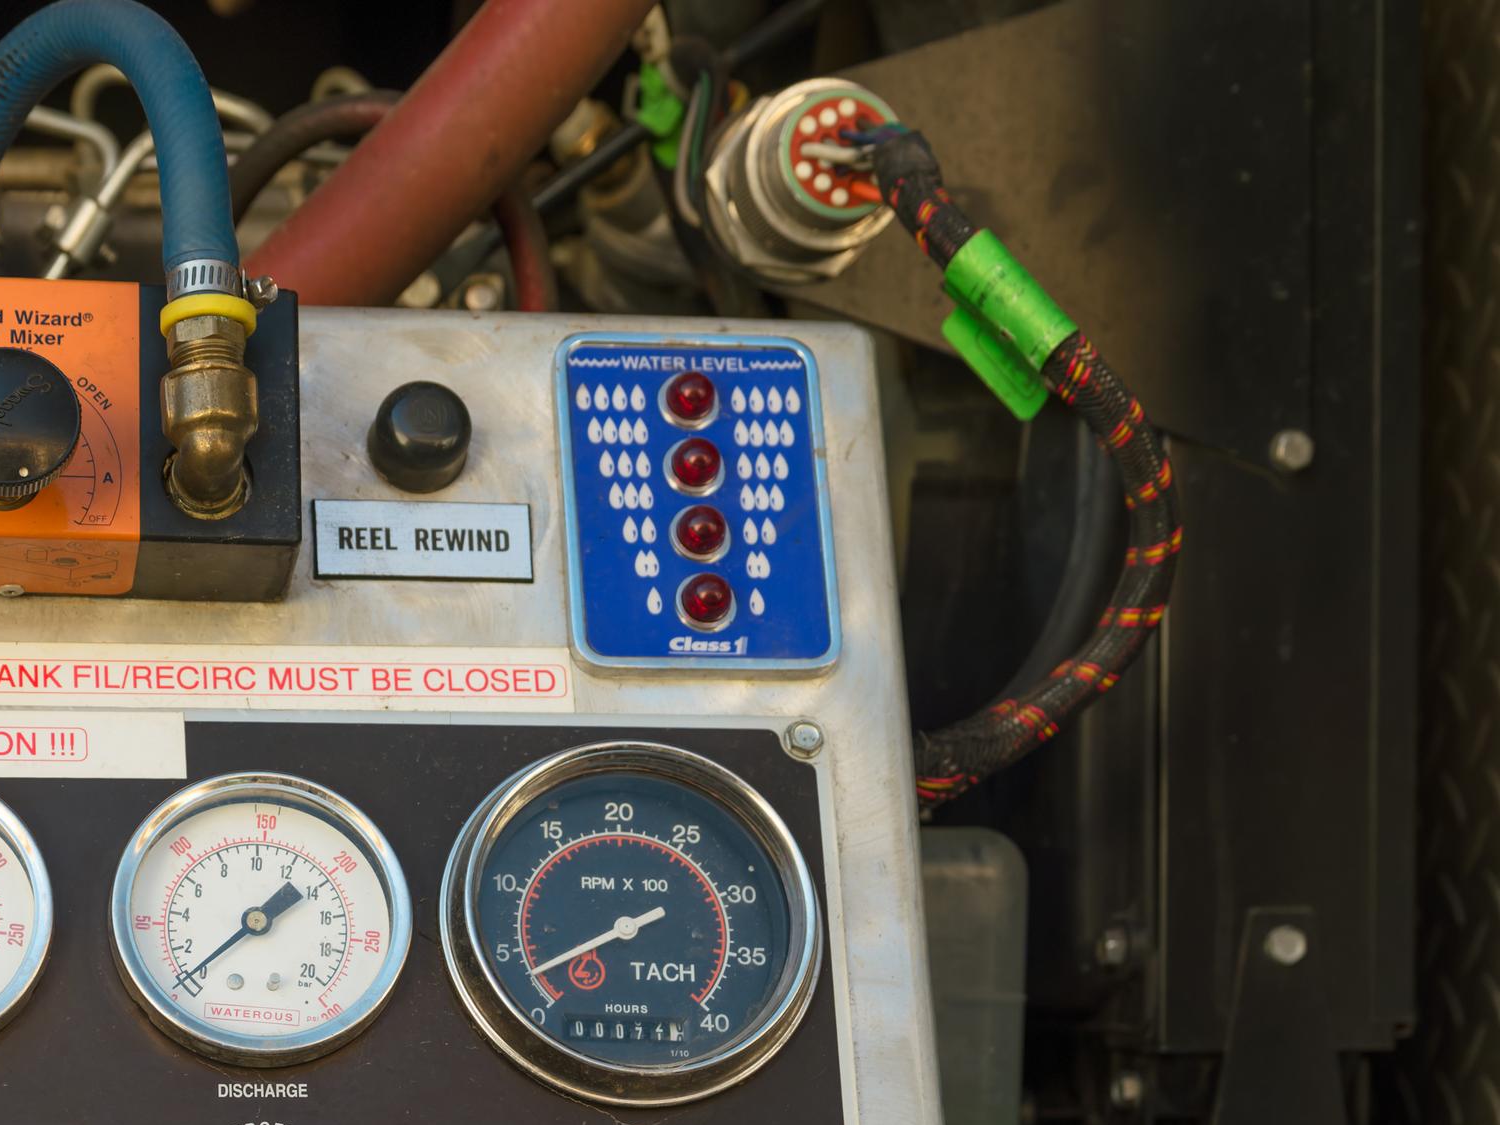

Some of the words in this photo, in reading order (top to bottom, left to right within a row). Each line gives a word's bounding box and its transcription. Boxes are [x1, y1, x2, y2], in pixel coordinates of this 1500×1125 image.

[10, 329, 64, 346] Mixer
[621, 355, 686, 371] WATER
[691, 356, 749, 372] LEVEL
[77, 376, 112, 411] OPEN
[103, 472, 113, 484] A
[338, 528, 397, 550] REEL
[415, 529, 510, 552] REWIND
[74, 664, 256, 690] FIL/RECIRC
[268, 667, 359, 691] MUST
[372, 668, 412, 692] BE
[423, 668, 556, 692] CLOSED
[50, 732, 75, 756] !!!
[604, 802, 634, 822] 20
[256, 814, 276, 829] 150
[540, 821, 563, 839] 15
[672, 824, 700, 843] 25
[169, 836, 192, 857] 100
[251, 858, 262, 871] 10
[333, 851, 357, 874] 200
[220, 864, 228, 878] 8
[280, 866, 292, 879] 12
[493, 874, 516, 891] 10
[581, 876, 615, 891] RPM
[623, 878, 634, 891] X
[642, 879, 668, 892] 100
[194, 884, 202, 898] 6
[306, 886, 318, 900] 14
[727, 885, 756, 904] 30
[136, 915, 151, 930] 50
[182, 908, 190, 922] 4
[319, 911, 332, 925] 16
[7, 923, 25, 947] 250
[364, 931, 381, 953] 250
[184, 939, 192, 954] 2
[320, 942, 332, 957] 18
[496, 944, 510, 961] 5
[737, 947, 766, 965] 35
[200, 965, 207, 979] 0
[300, 963, 315, 978] 20
[630, 962, 695, 982] TACH
[298, 980, 312, 988] bar
[210, 1006, 293, 1022] WATEROUS
[605, 1003, 649, 1014] HOURS
[701, 1014, 730, 1032] 40
[671, 1049, 689, 1058] 1/10
[218, 1084, 308, 1098] DISCHARGE
